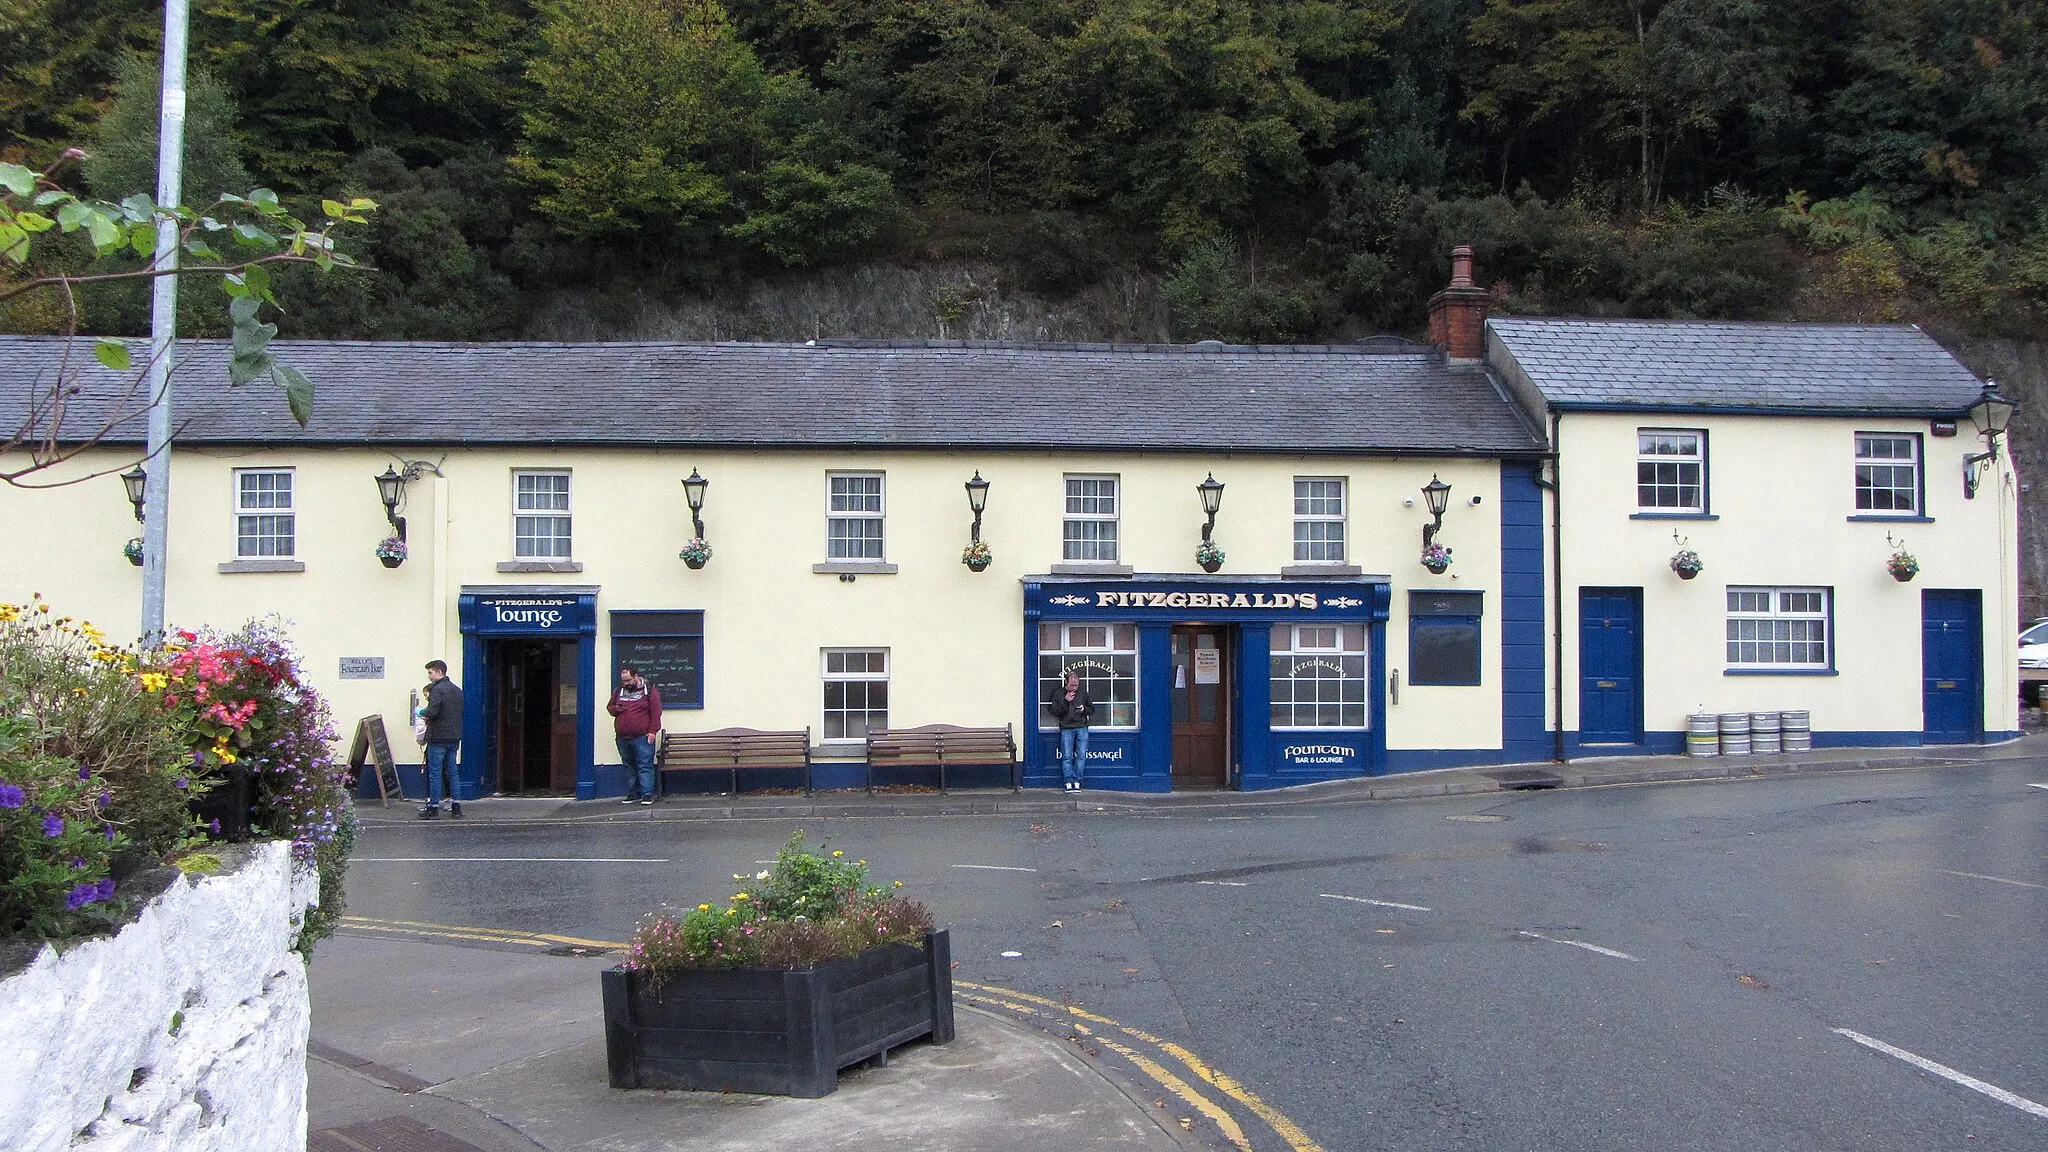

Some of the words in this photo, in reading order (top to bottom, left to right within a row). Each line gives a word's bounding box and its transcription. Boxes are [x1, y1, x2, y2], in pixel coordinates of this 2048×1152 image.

[1096, 591, 1319, 610] FITZGERALD'S
[495, 606, 563, 628] lounge
[341, 664, 369, 674] Fountain
[1295, 756, 1309, 764] BAR
[1316, 756, 1344, 764] LOUNGE
